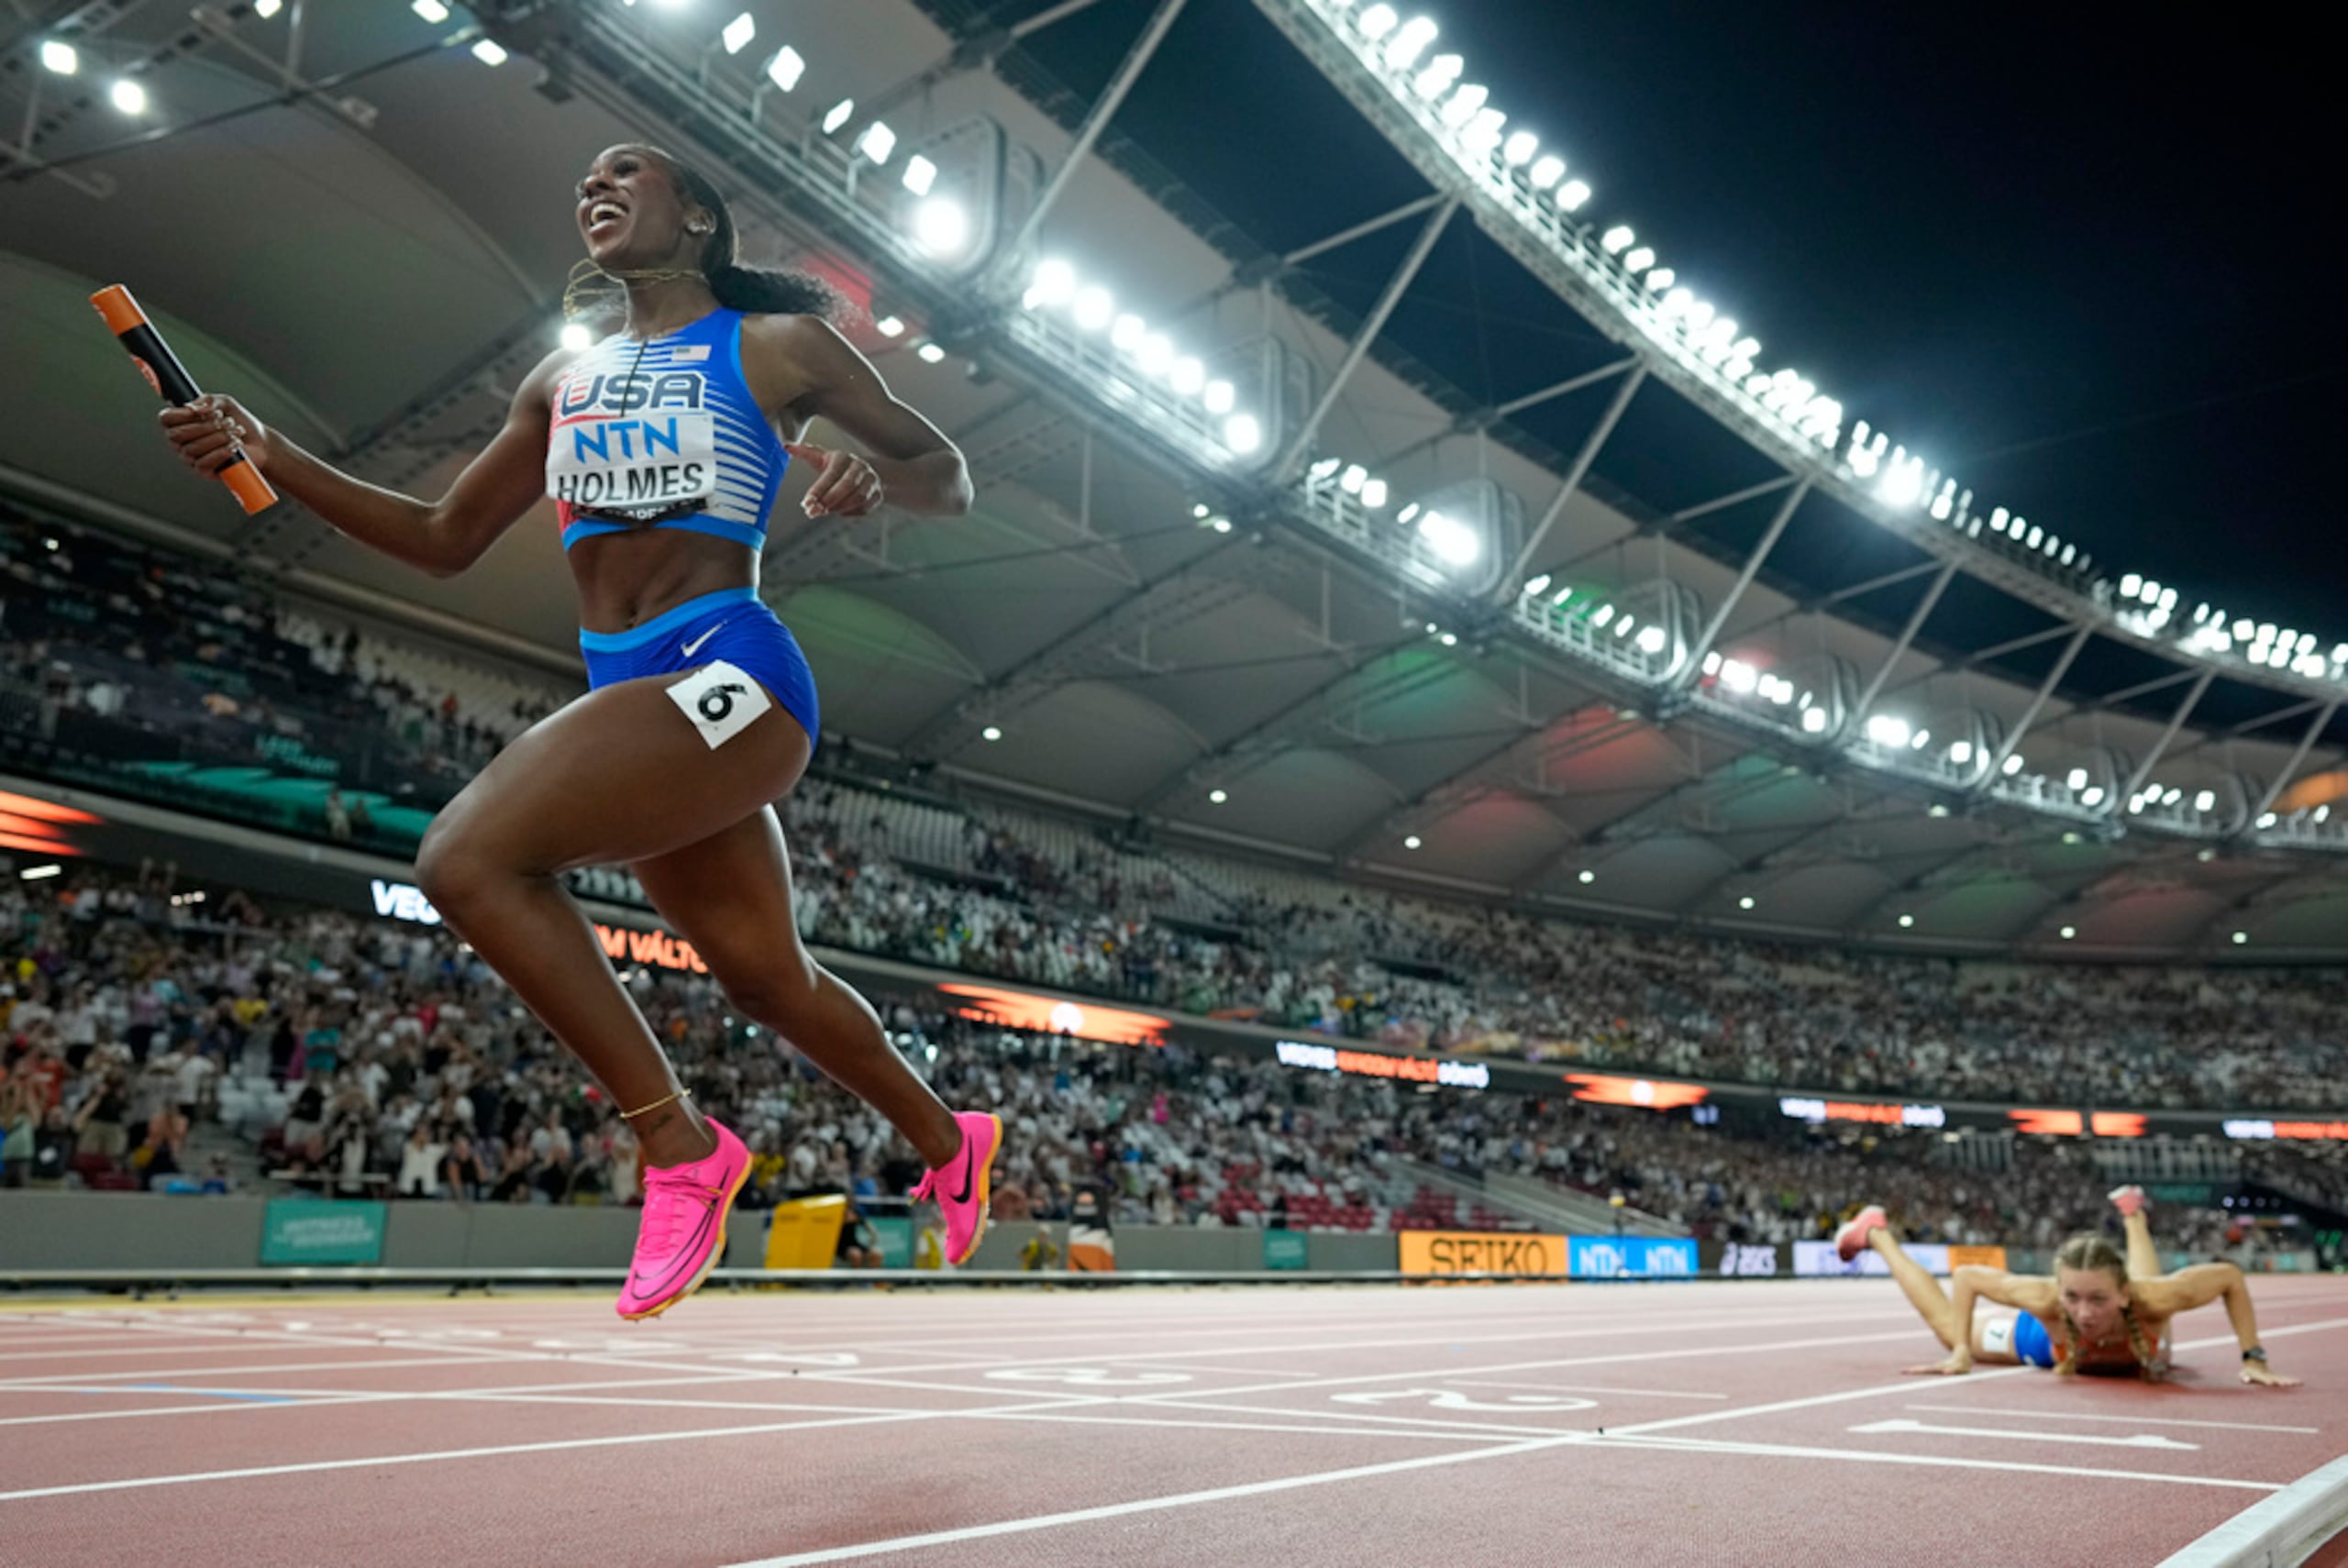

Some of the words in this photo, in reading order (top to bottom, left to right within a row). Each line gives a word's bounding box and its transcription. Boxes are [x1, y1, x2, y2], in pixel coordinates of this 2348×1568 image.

[560, 372, 703, 417] USA
[572, 417, 680, 464] NTN
[557, 463, 704, 503] HOLMES
[697, 683, 748, 722] 6
[1429, 1238, 1548, 1276] SEIKO
